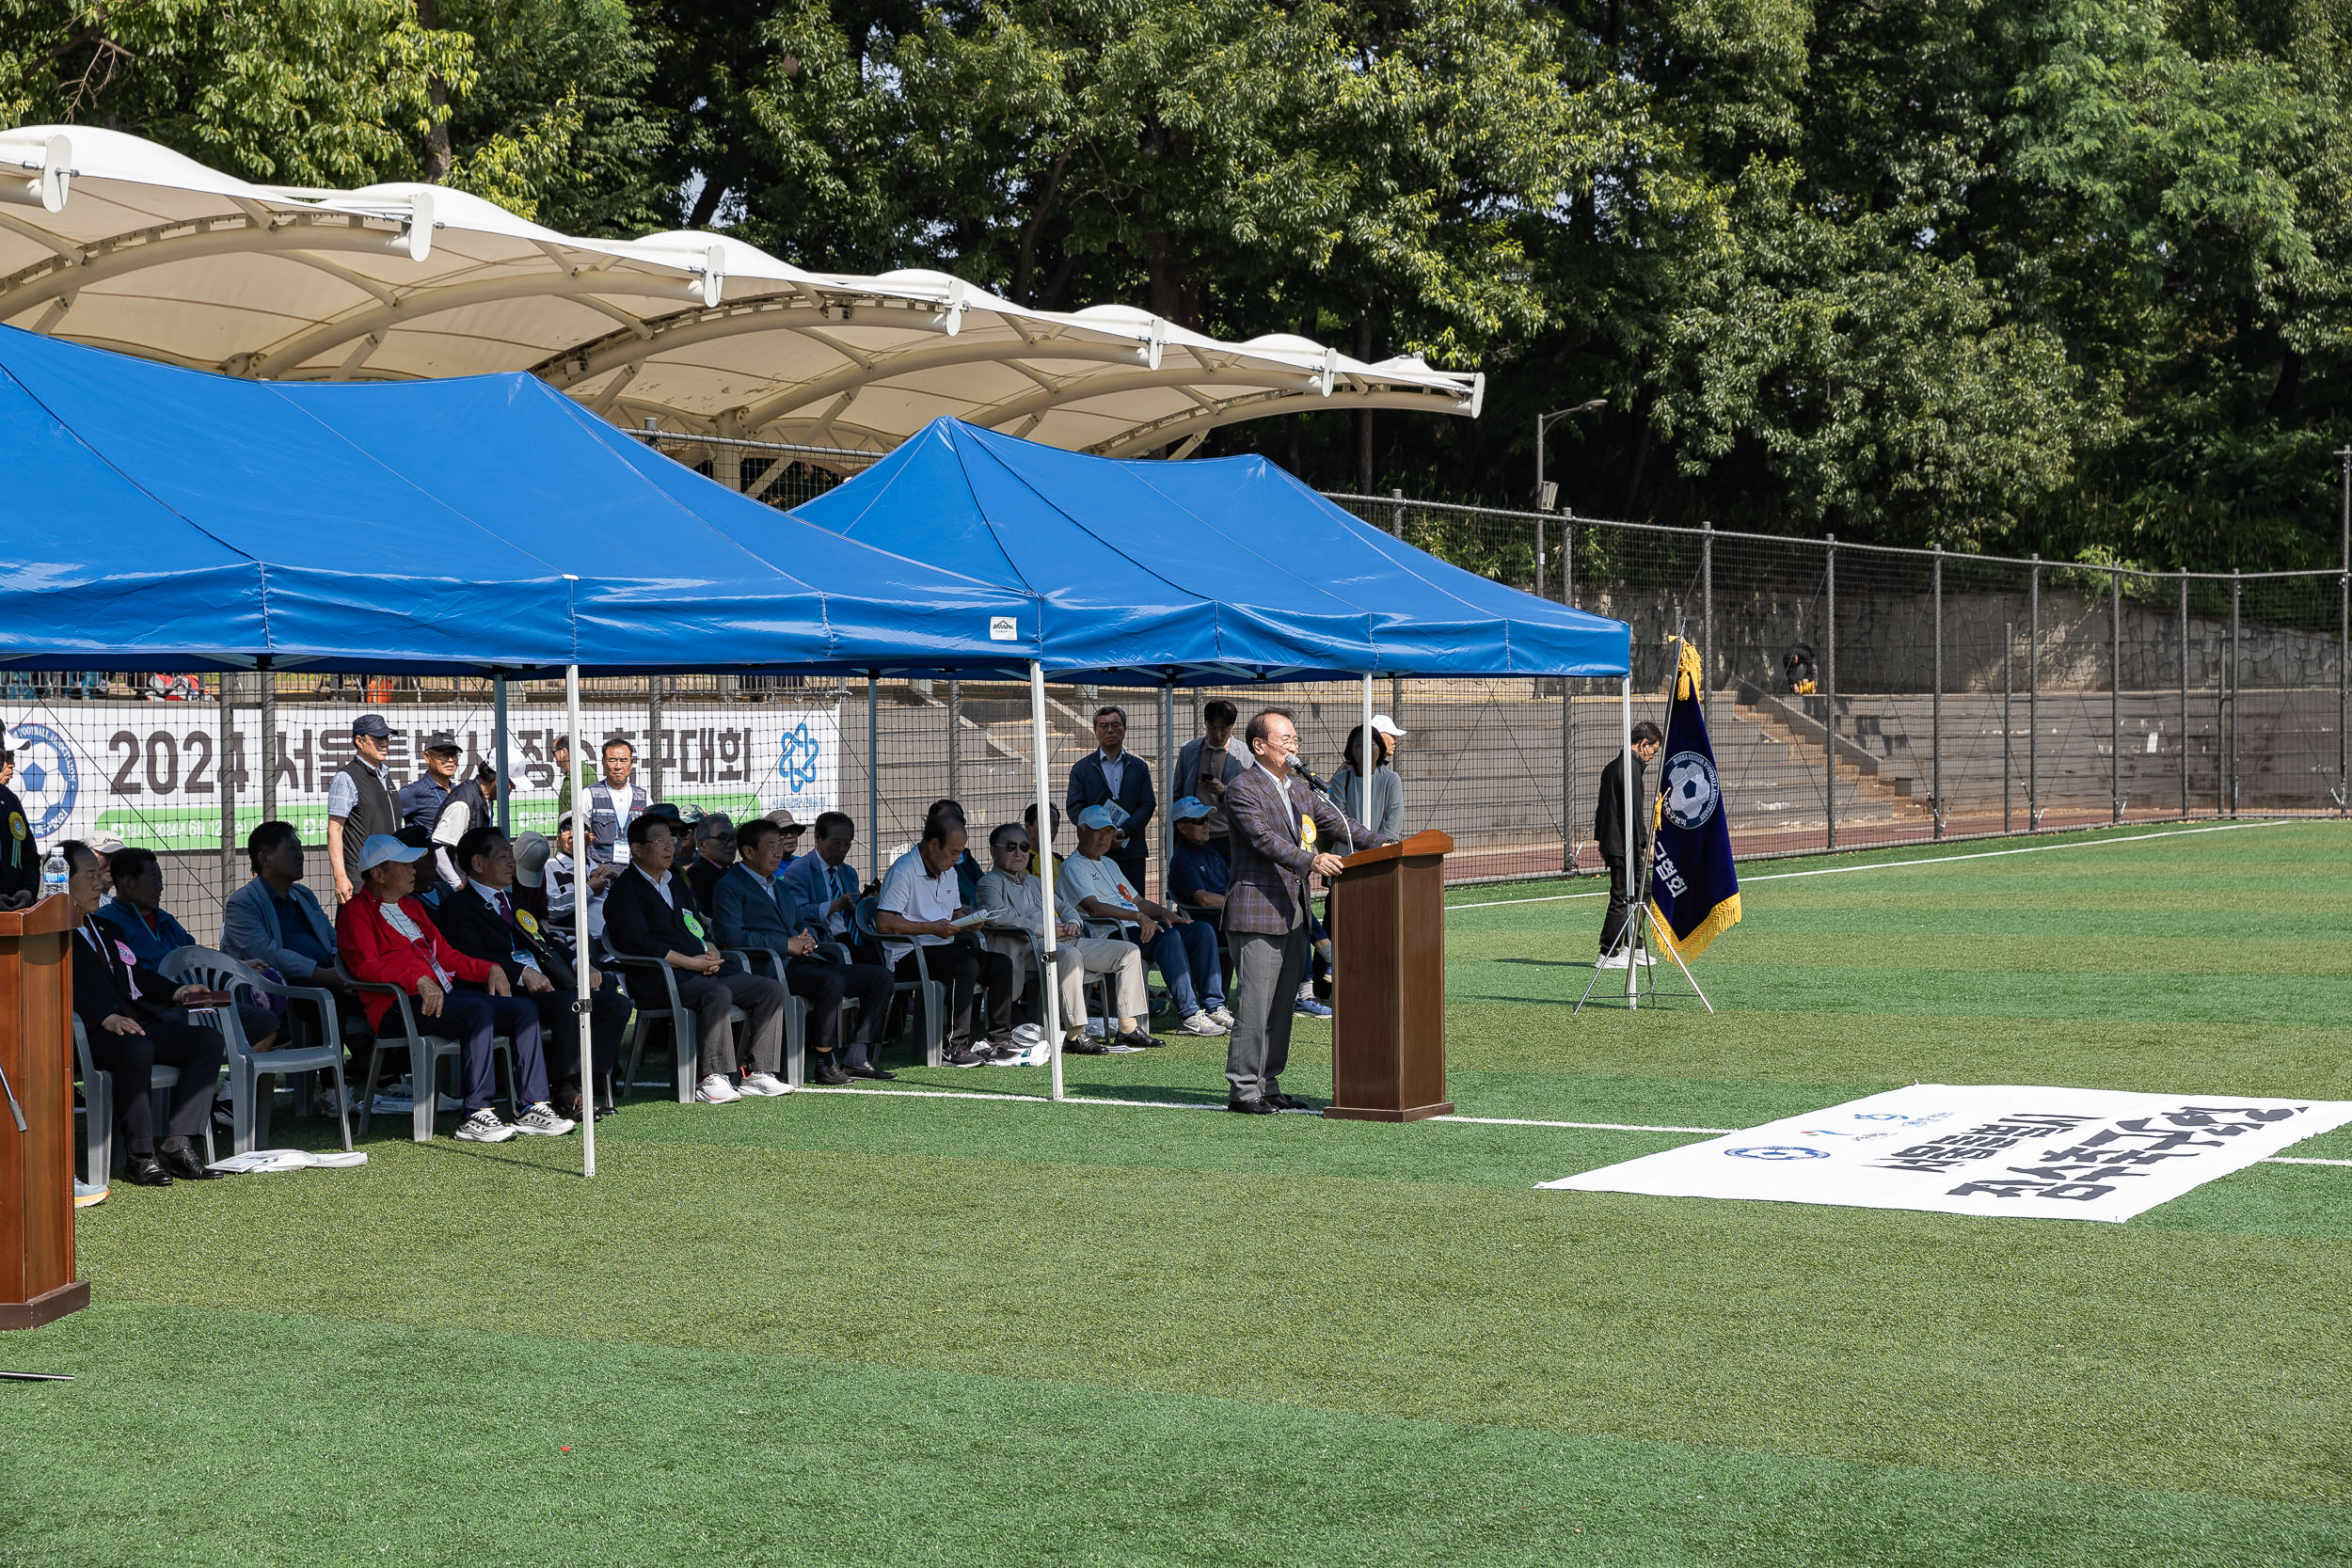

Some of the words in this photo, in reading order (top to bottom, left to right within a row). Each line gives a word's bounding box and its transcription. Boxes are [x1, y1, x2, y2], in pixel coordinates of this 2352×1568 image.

[18, 725, 50, 739] FOOTBALL
[49, 733, 76, 782] ASSOCIATION
[108, 730, 248, 795] 2024
[518, 727, 752, 788] 장구대회
[189, 819, 206, 837] 6월
[1860, 1114, 2106, 1173] 서울특별시
